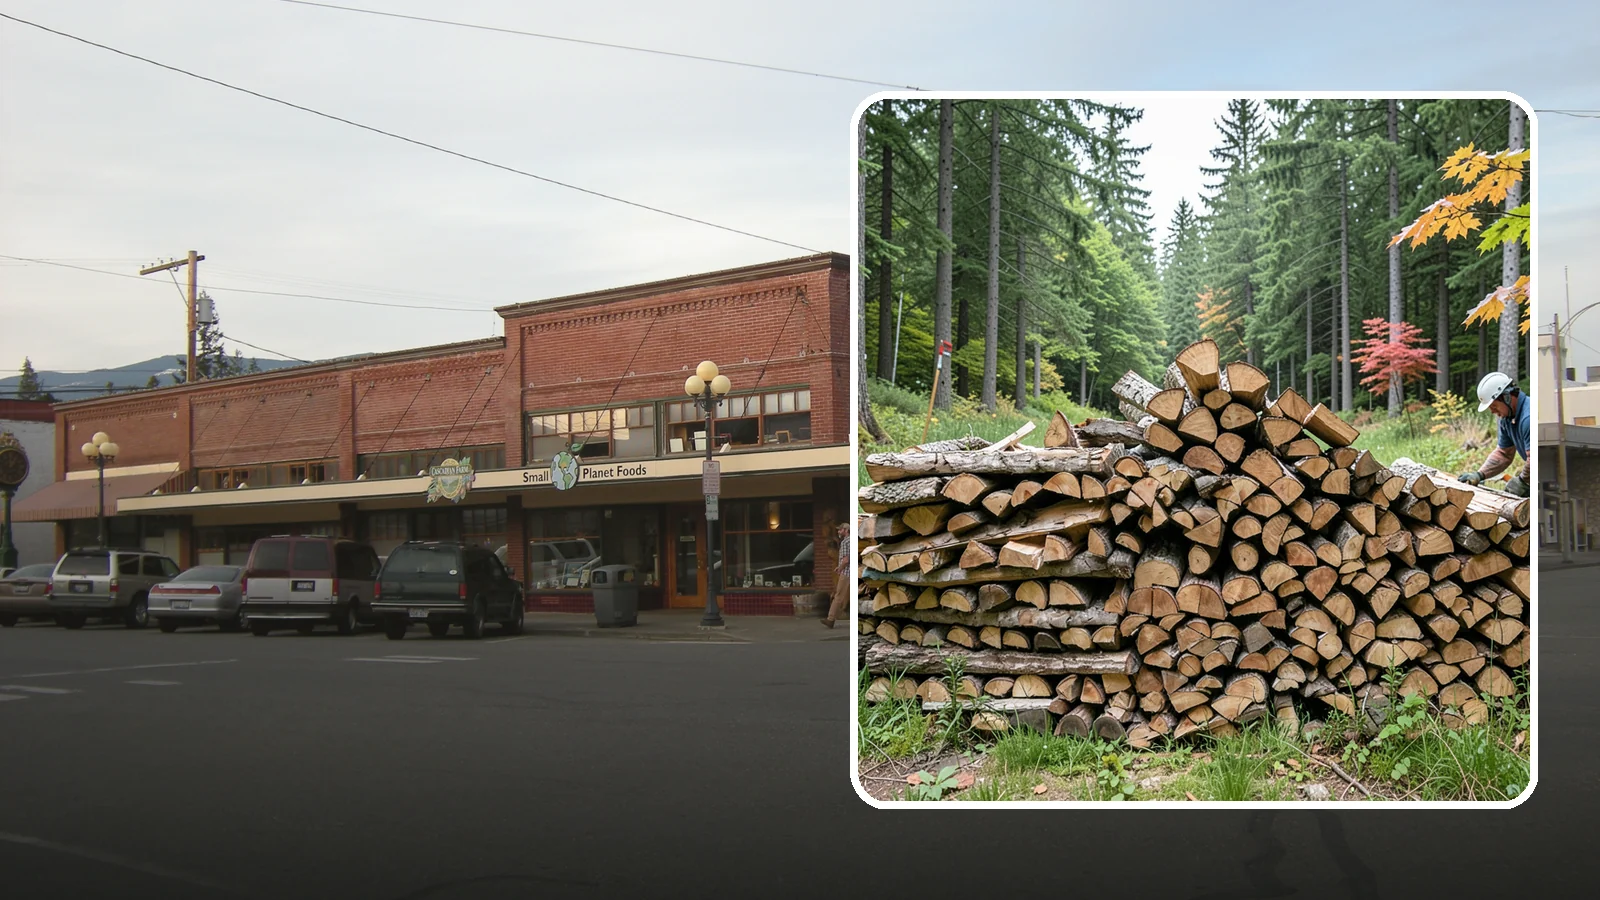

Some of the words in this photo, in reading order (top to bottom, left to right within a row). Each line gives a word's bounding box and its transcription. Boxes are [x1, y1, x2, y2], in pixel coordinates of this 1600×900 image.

[523, 471, 549, 483] Small
[583, 468, 614, 479] Planet
[617, 464, 647, 476] Foods
